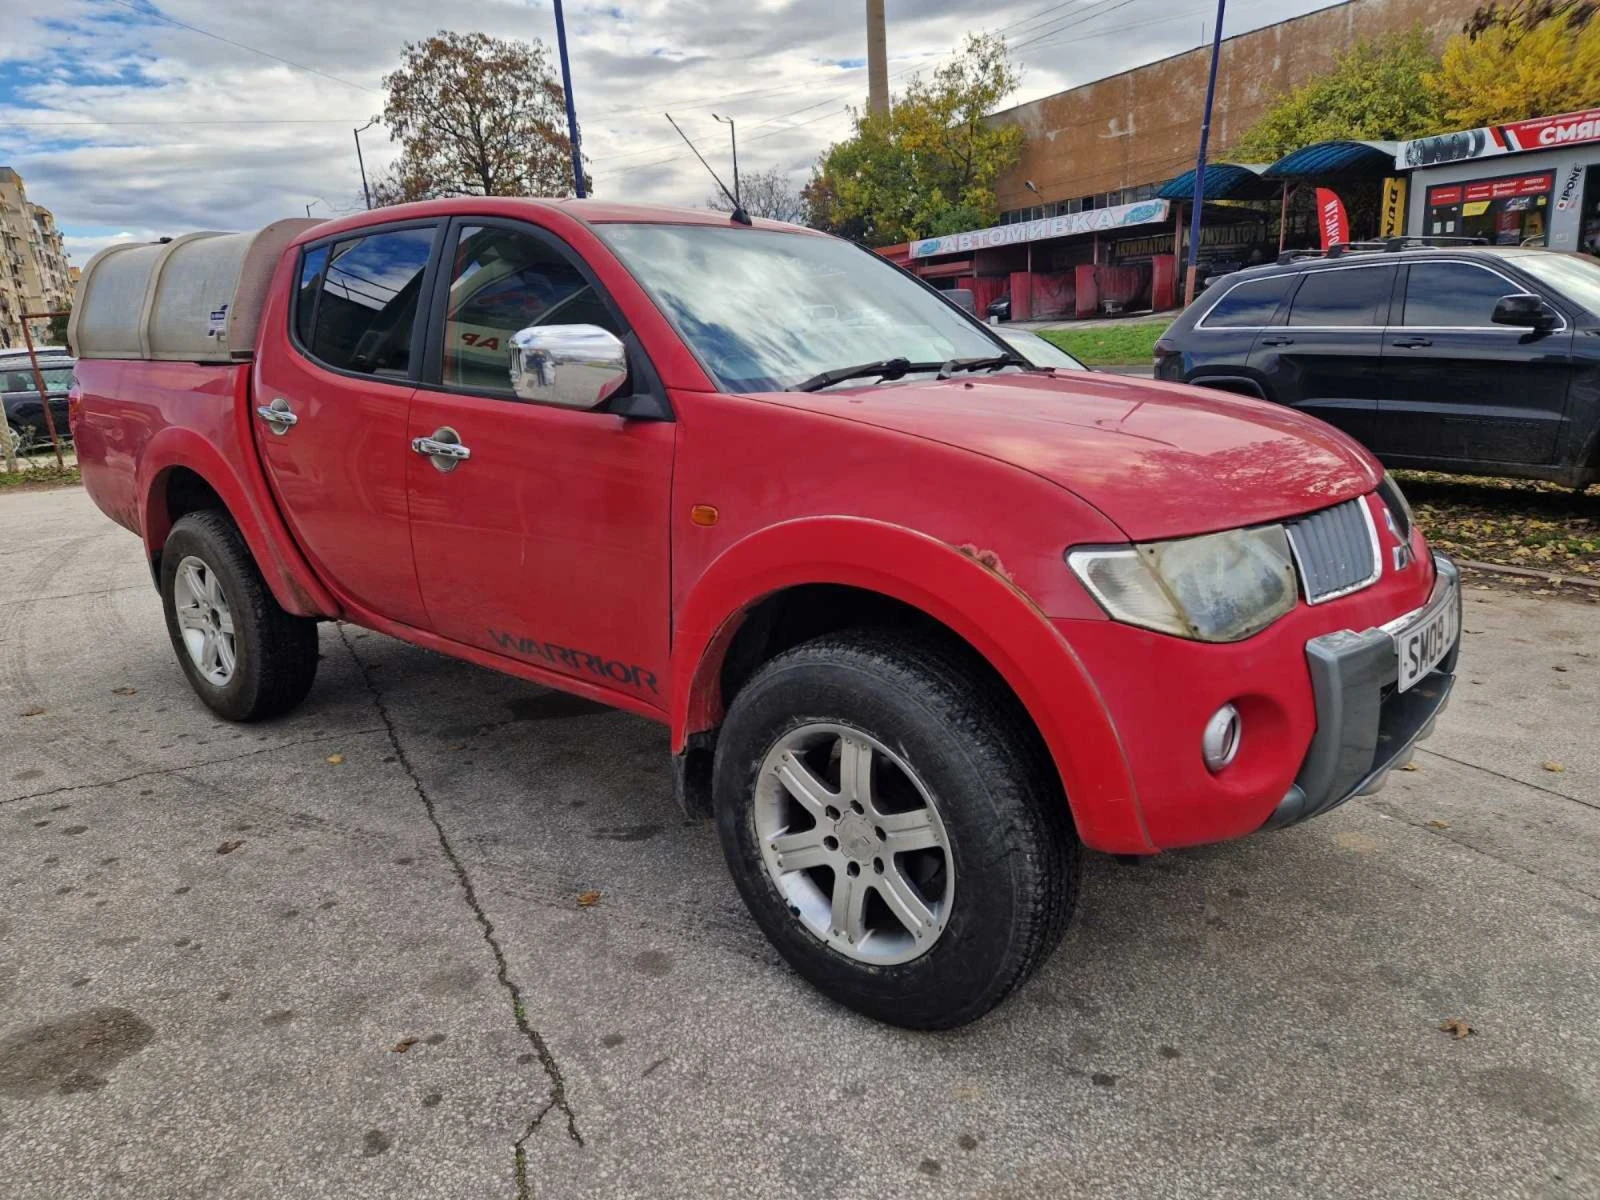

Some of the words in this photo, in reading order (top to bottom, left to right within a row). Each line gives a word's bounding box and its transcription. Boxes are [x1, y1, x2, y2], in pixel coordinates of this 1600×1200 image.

[1561, 165, 1582, 201] IPONE
[941, 206, 1116, 253] АВТОМИВКА
[488, 629, 658, 695] WARRIOR
[1408, 614, 1444, 679] SM09
